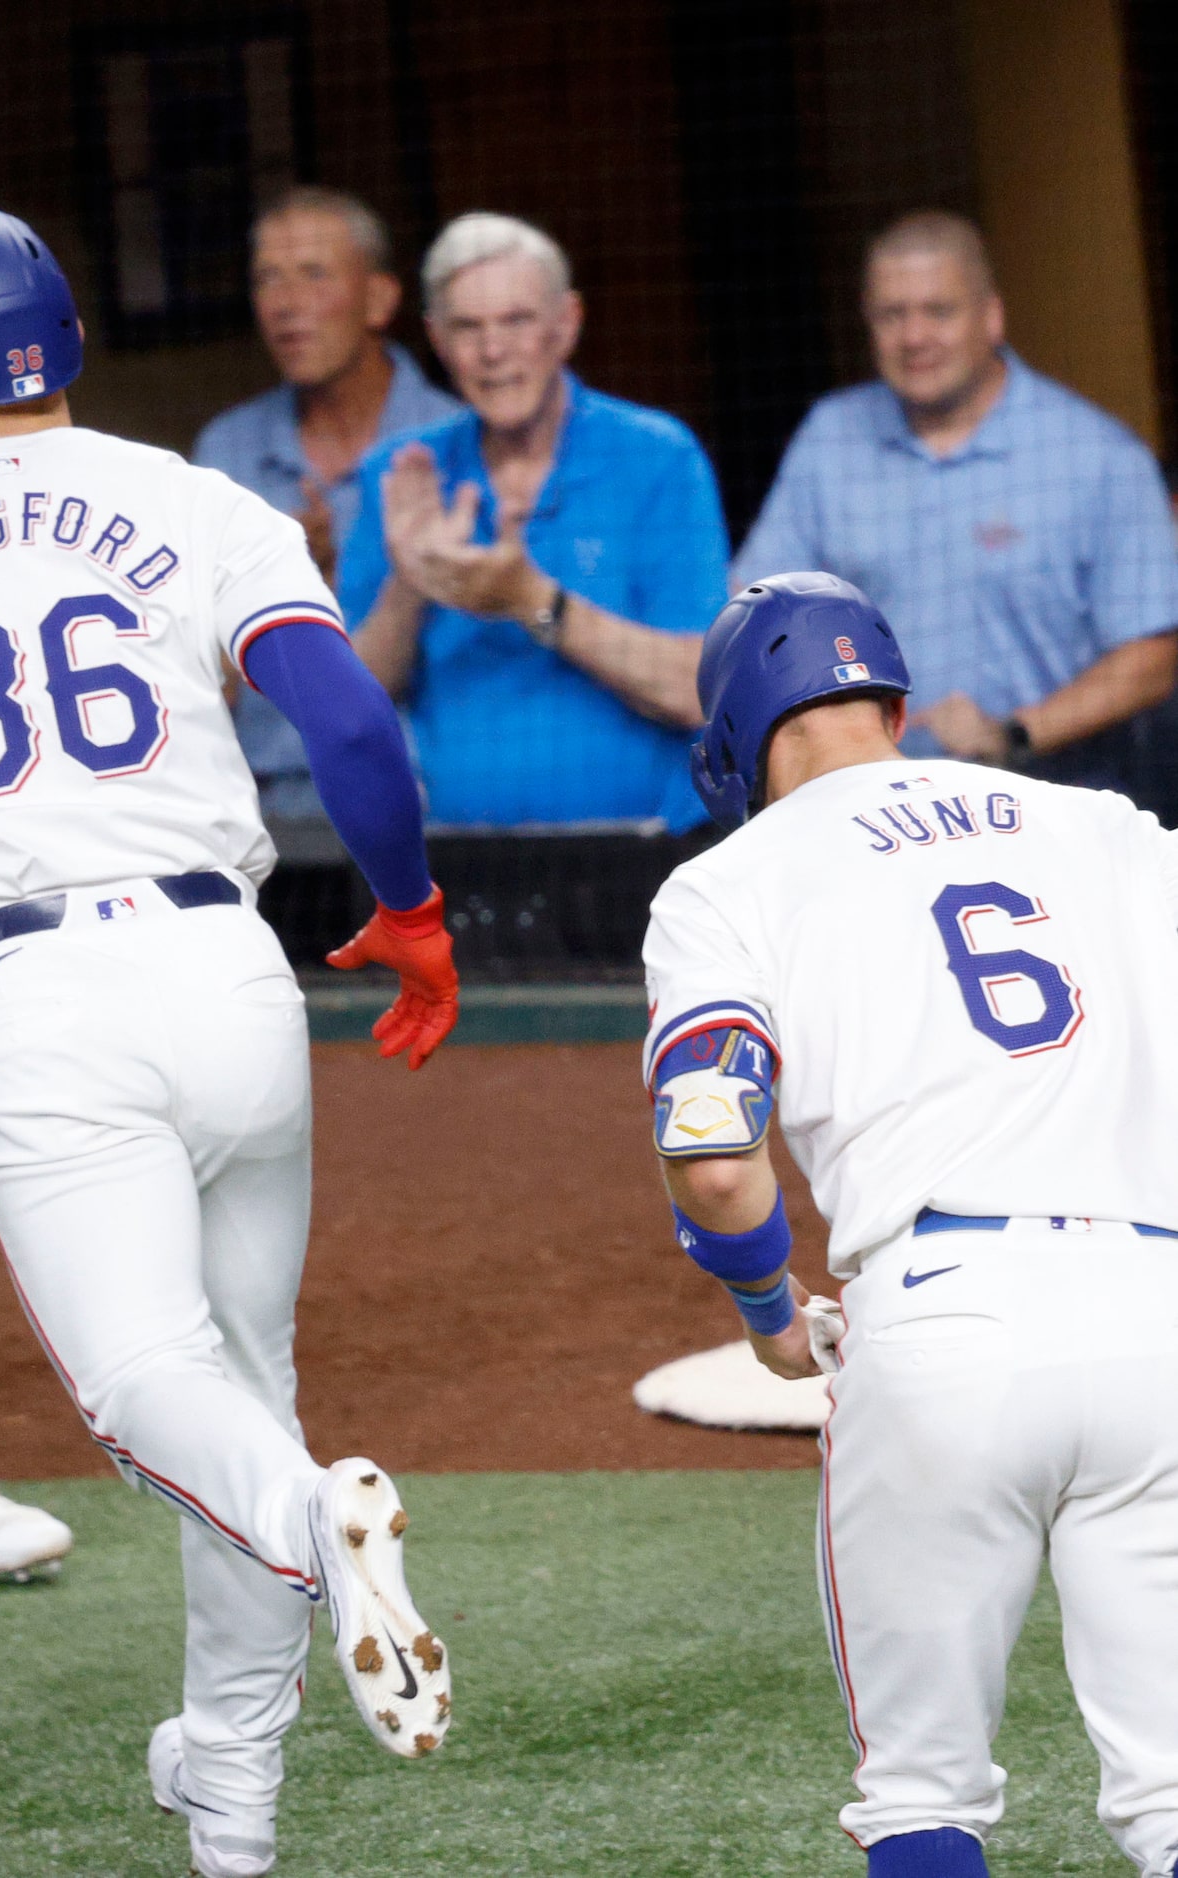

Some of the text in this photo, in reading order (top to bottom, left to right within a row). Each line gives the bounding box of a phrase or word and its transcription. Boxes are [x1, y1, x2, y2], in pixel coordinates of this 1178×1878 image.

[6, 344, 44, 375] 36
[834, 637, 856, 661] 6
[852, 793, 1022, 855] JUNG
[930, 881, 1086, 1058] 6
[745, 1039, 766, 1079] T
